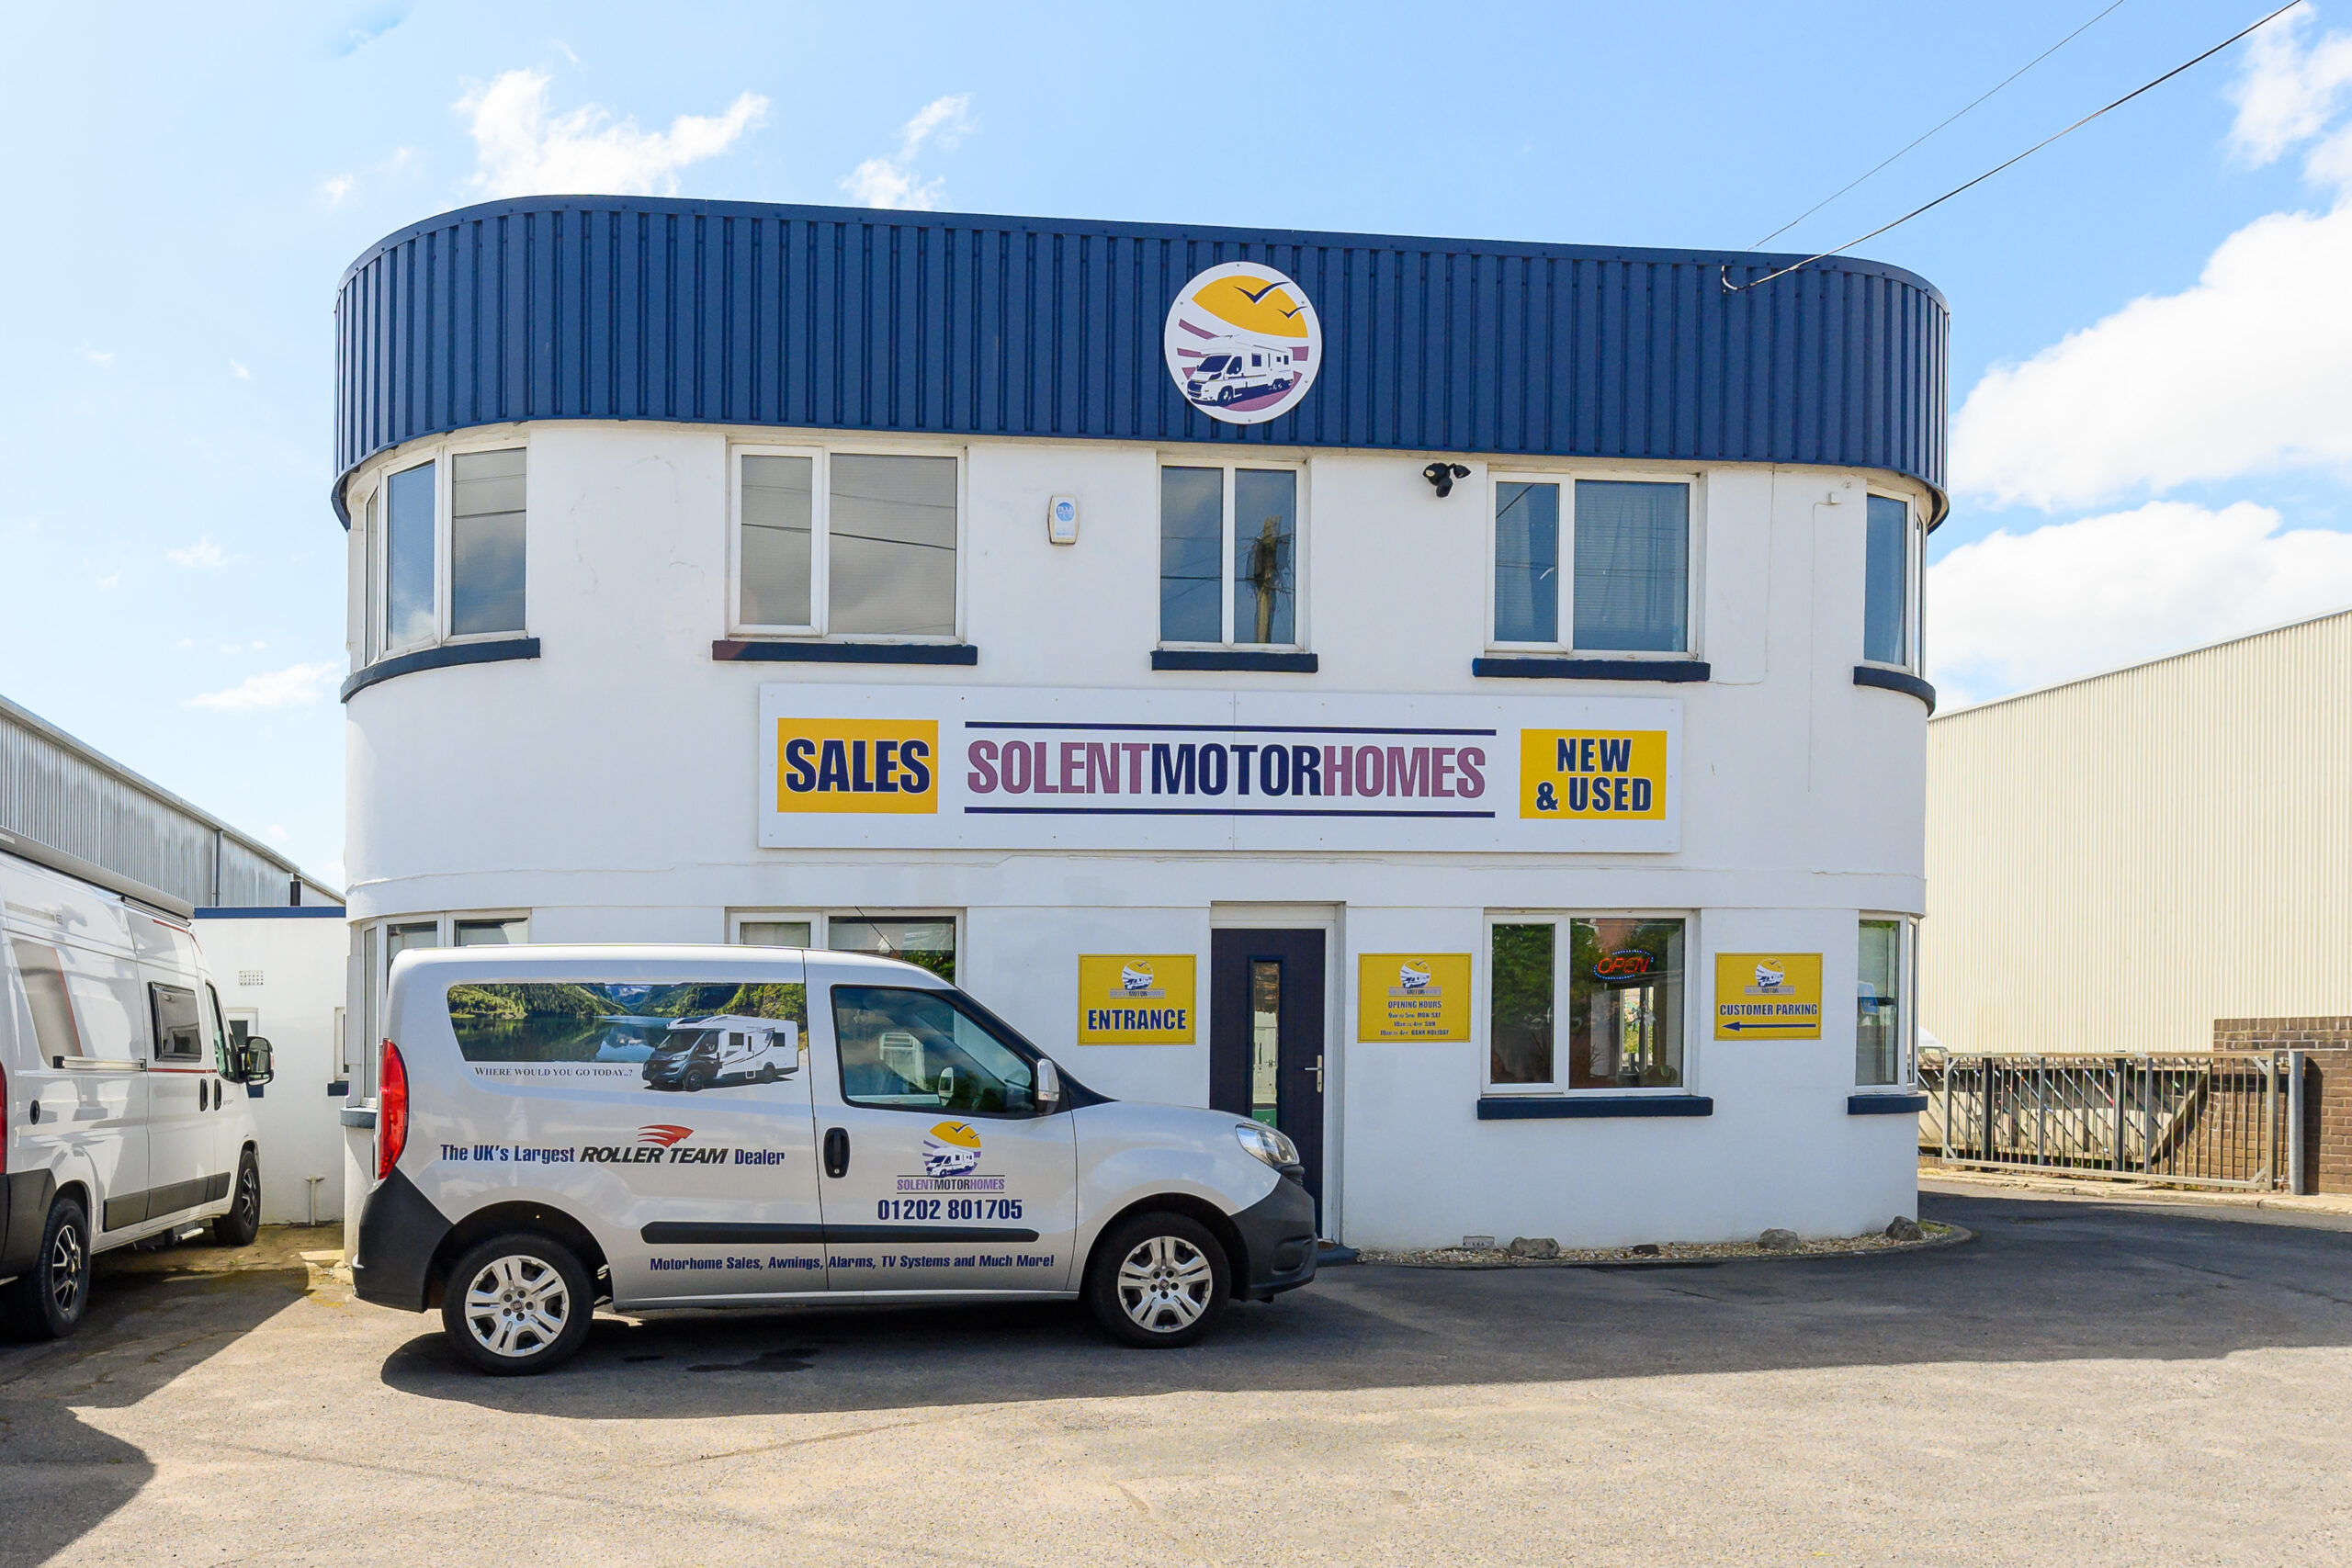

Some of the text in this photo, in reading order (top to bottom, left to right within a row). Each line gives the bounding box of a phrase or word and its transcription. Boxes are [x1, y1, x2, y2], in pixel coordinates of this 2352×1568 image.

[1555, 738, 1632, 773] NEW
[785, 738, 932, 795] SALES
[967, 739, 1487, 799] SOLENTMOTORHOMES
[1536, 777, 1653, 813] & USED
[1598, 957, 1650, 974] OPEN
[1388, 1000, 1442, 1009] OPENING HOURS
[1720, 1004, 1817, 1015] CUSTOMER PARKING
[1088, 1009, 1187, 1030] ENTRANCE
[475, 1066, 512, 1076] WHERE
[553, 1068, 572, 1077] YOU
[575, 1068, 590, 1077] GO
[440, 1145, 785, 1165] The UK's Largest ROLLER TEAM Dealer
[897, 1179, 1005, 1190] SOLENTMOTORHOMES
[877, 1199, 1023, 1220] 01202 801705
[650, 1254, 1055, 1270] Motorhome Sales, Awnings, Alarms, TV Systems and Much More!
